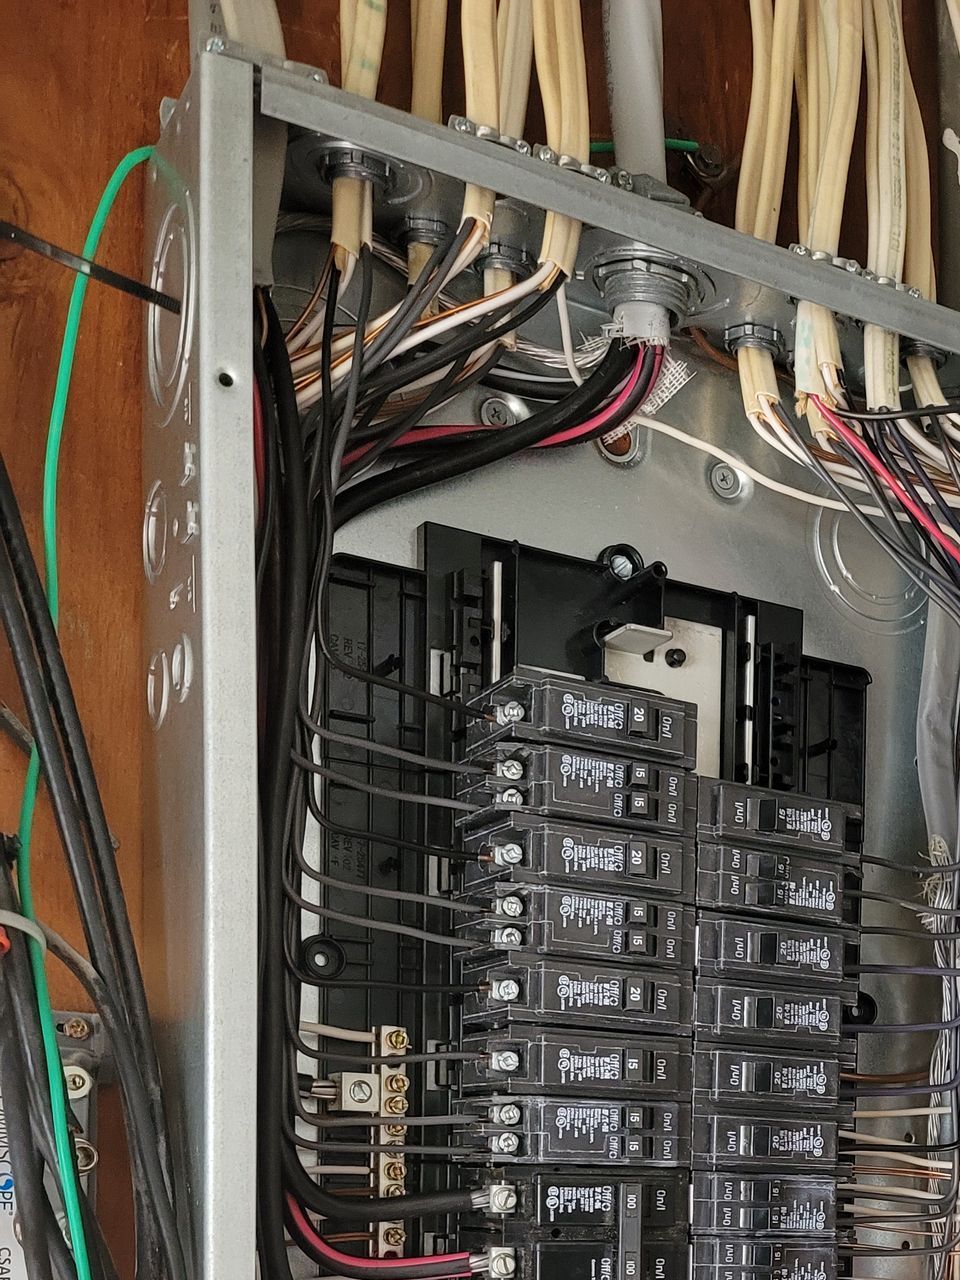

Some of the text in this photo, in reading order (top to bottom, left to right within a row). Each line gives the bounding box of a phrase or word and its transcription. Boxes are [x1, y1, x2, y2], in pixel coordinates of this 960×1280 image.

[634, 708, 644, 721] 20
[662, 717, 672, 738] On/I
[636, 768, 645, 777] 15
[669, 777, 678, 796] On/I
[635, 798, 644, 806] 15
[668, 804, 676, 822] On/I
[734, 802, 744, 823] On/I
[778, 809, 786, 820] 15
[632, 850, 642, 864] 20
[661, 853, 670, 874] On/I
[732, 850, 740, 868] On/I
[778, 864, 784, 874] 15
[731, 876, 739, 894] On/I
[778, 889, 784, 898] 15
[634, 908, 643, 916] 15
[667, 912, 676, 930] On/I
[634, 936, 642, 945] 15
[734, 938, 744, 958] On/I
[666, 939, 675, 958] On/I
[780, 942, 786, 955] 20
[630, 987, 640, 1000] 20
[658, 990, 668, 1010] On/I
[732, 1000, 741, 1020] On/I
[776, 1006, 782, 1019] 20
[629, 1059, 638, 1069] 15
[657, 1060, 666, 1080] On/I
[730, 1065, 740, 1085] On/I
[774, 1072, 780, 1084] 20
[630, 1113, 640, 1122] 15
[664, 1112, 672, 1131] On/I
[630, 1142, 638, 1150] 15
[663, 1140, 672, 1158] On/I
[727, 1132, 736, 1151] On/I
[772, 1136, 780, 1148] 20
[724, 1182, 733, 1200] On/I
[772, 1188, 779, 1196] 15
[627, 1195, 636, 1208] 100
[656, 1190, 666, 1211] On/I
[722, 1208, 732, 1225] On/I
[772, 1215, 779, 1224] 15
[726, 1244, 734, 1262] On/I
[774, 1252, 780, 1260] 15
[626, 1261, 635, 1275] 100
[656, 1258, 665, 1278] On/I
